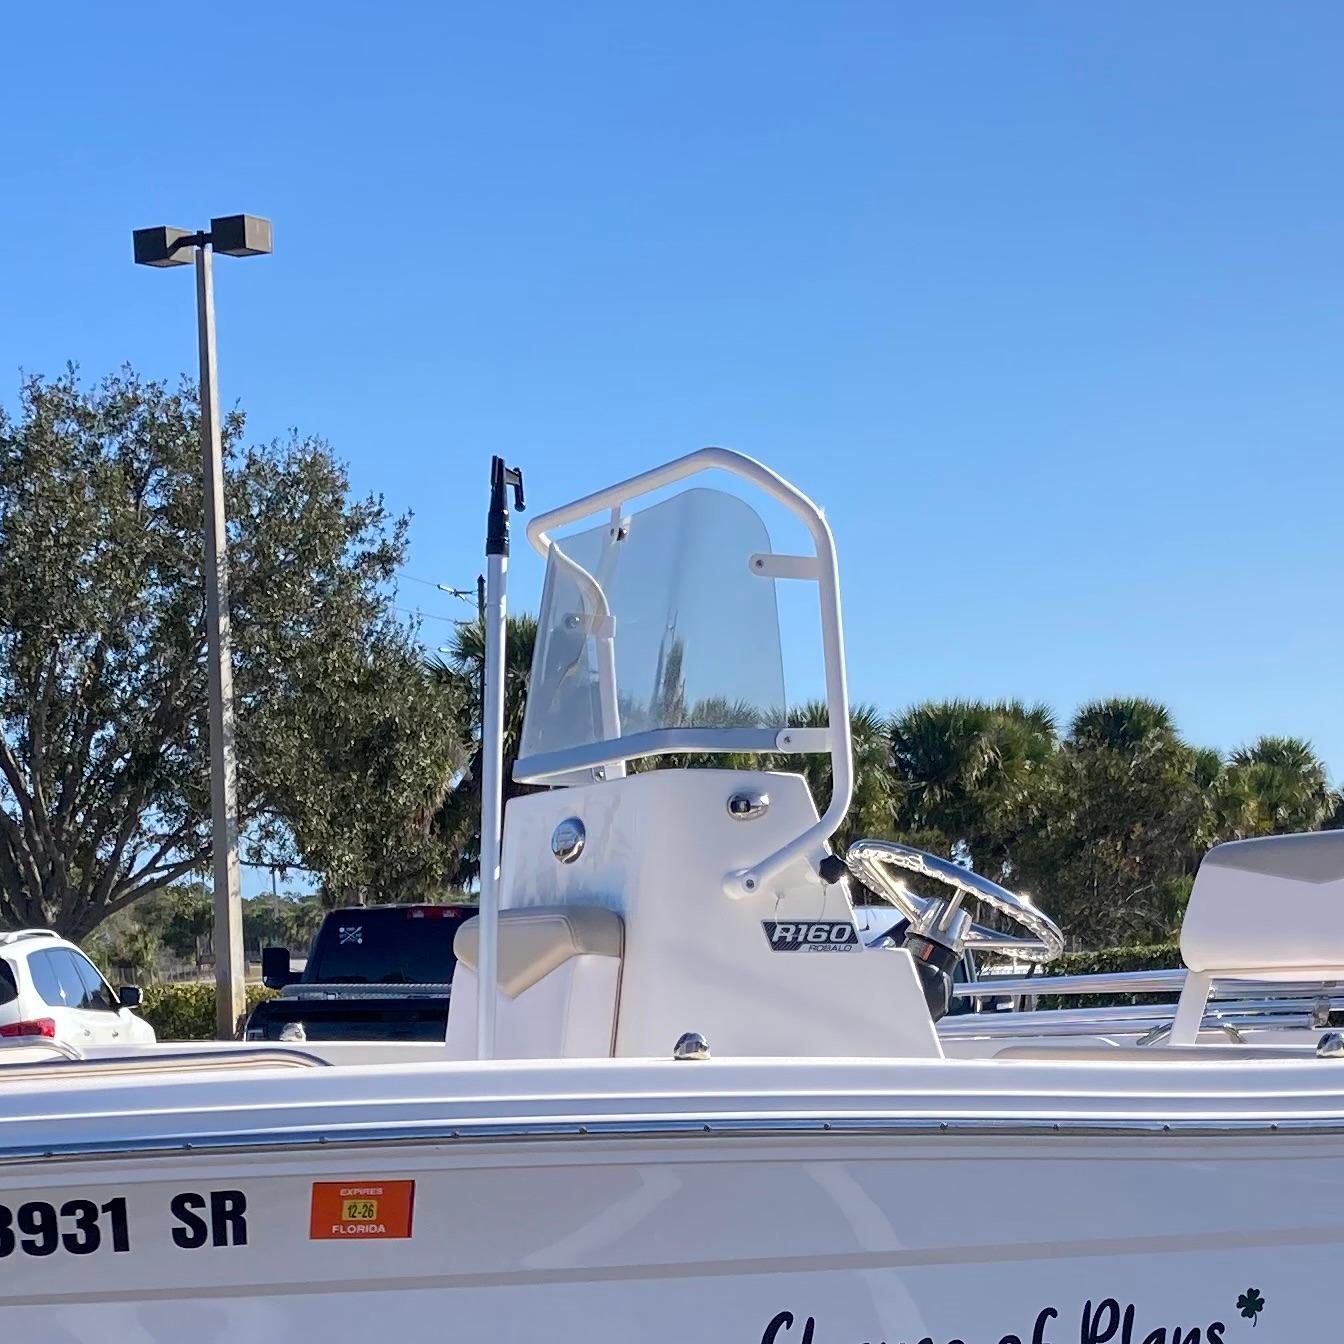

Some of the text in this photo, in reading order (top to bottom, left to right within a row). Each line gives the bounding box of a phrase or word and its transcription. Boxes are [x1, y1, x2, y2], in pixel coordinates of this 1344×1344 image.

[772, 924, 852, 942] R160
[808, 944, 853, 952] ROBALO
[340, 1187, 384, 1196] EXPIRES
[347, 1204, 374, 1219] 12-26
[170, 1190, 248, 1249] SR
[332, 1224, 386, 1234] FLORIDA
